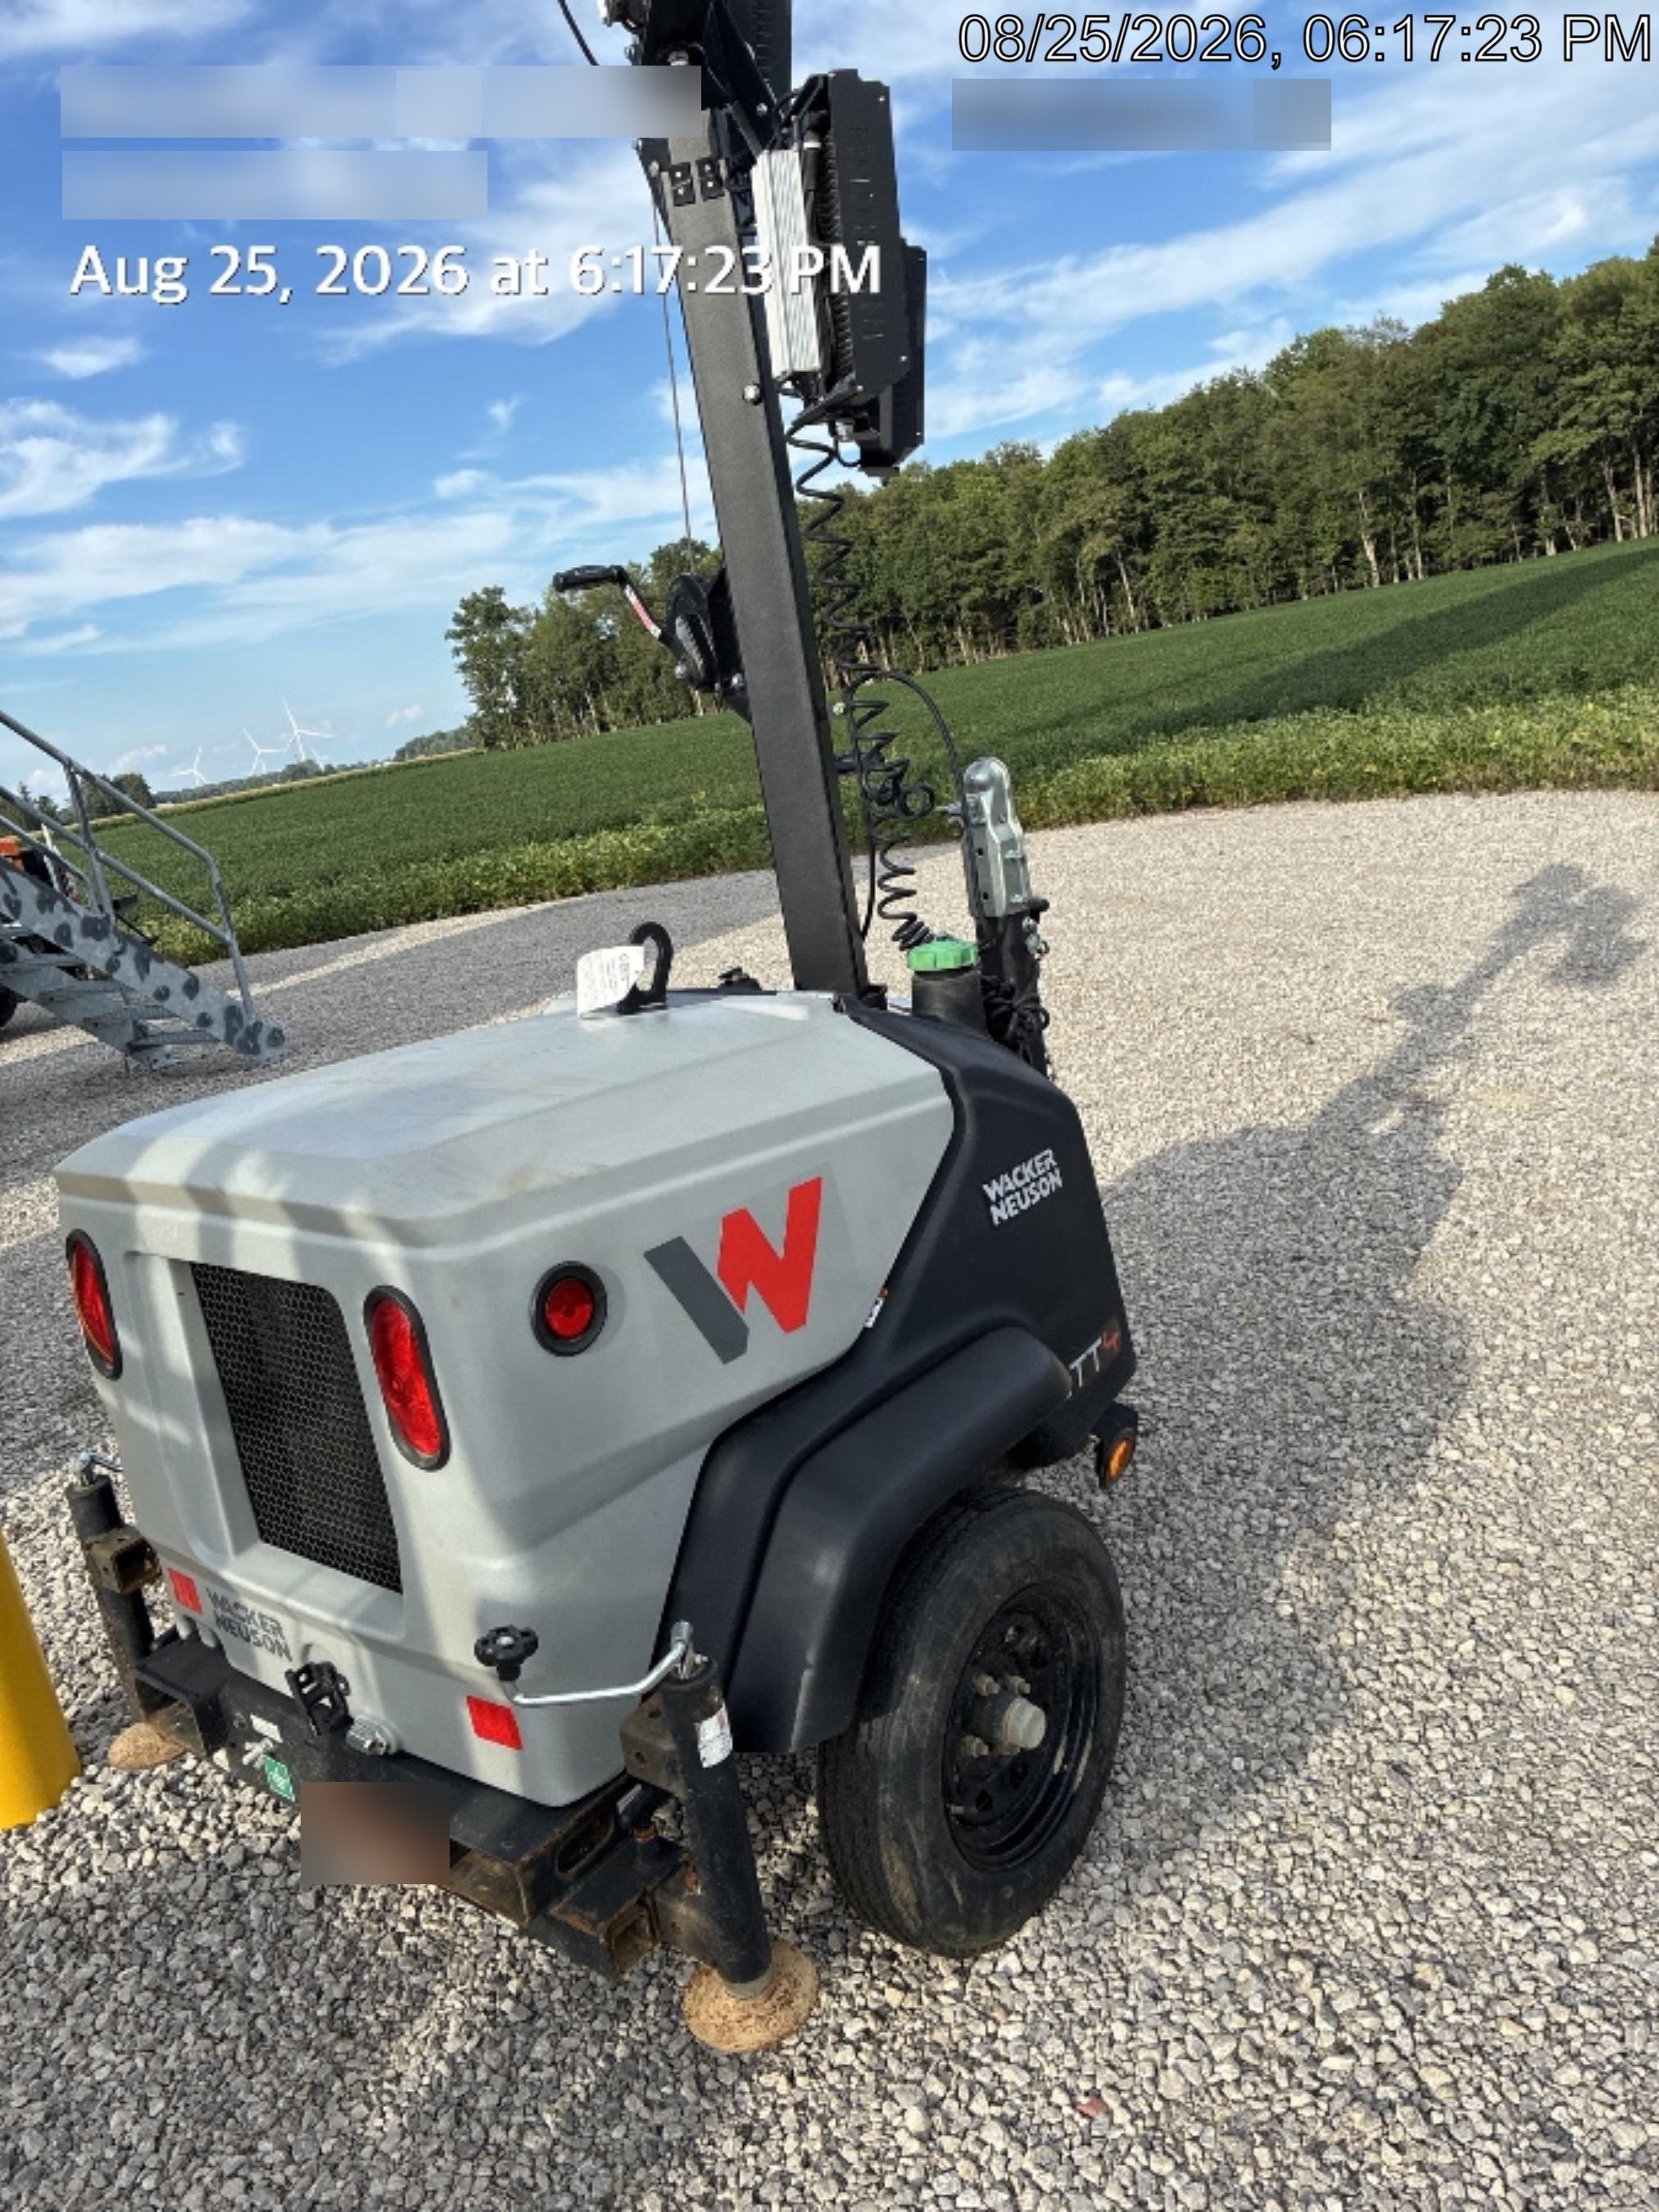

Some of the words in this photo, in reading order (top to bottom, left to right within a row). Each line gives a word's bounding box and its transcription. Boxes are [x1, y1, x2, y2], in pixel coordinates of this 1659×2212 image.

[982, 1147, 1058, 1203] WACKER
[990, 1167, 1063, 1226] NEUSON
[206, 1587, 286, 1640] WACKER
[213, 1611, 293, 1662] NEUSON
